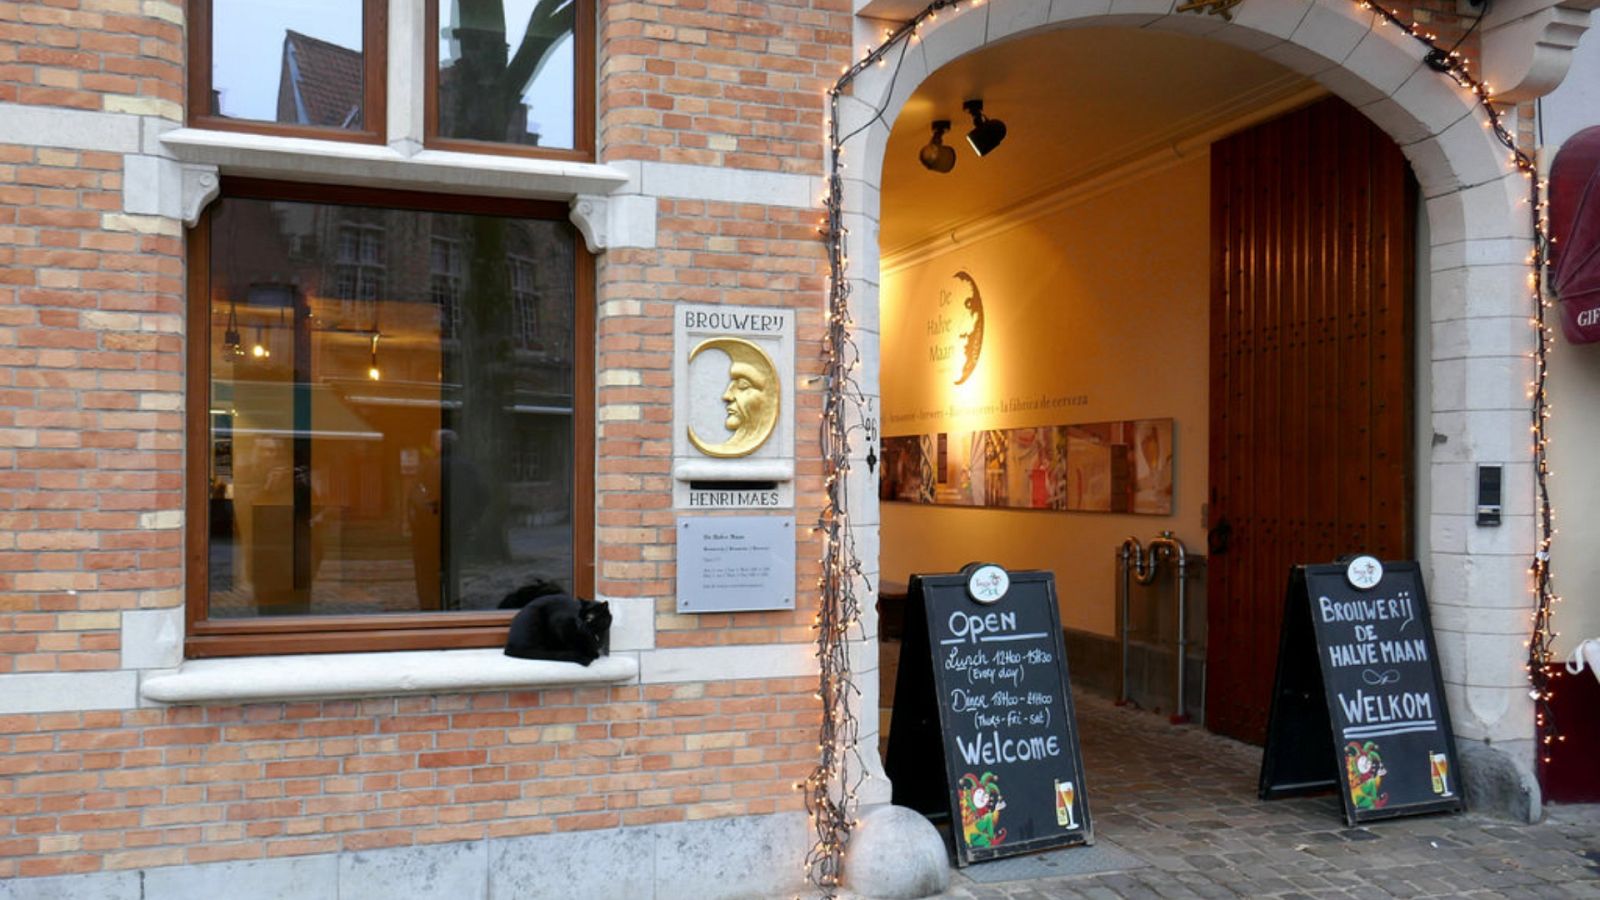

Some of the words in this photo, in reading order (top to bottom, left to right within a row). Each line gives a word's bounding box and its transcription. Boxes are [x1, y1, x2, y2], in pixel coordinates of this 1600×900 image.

[689, 491, 734, 506] HENRI
[738, 492, 779, 506] MAES
[1354, 624, 1378, 642] DE
[1329, 643, 1378, 667] HALVE
[1380, 639, 1427, 663] MAAN
[1337, 689, 1432, 723] WELKOM
